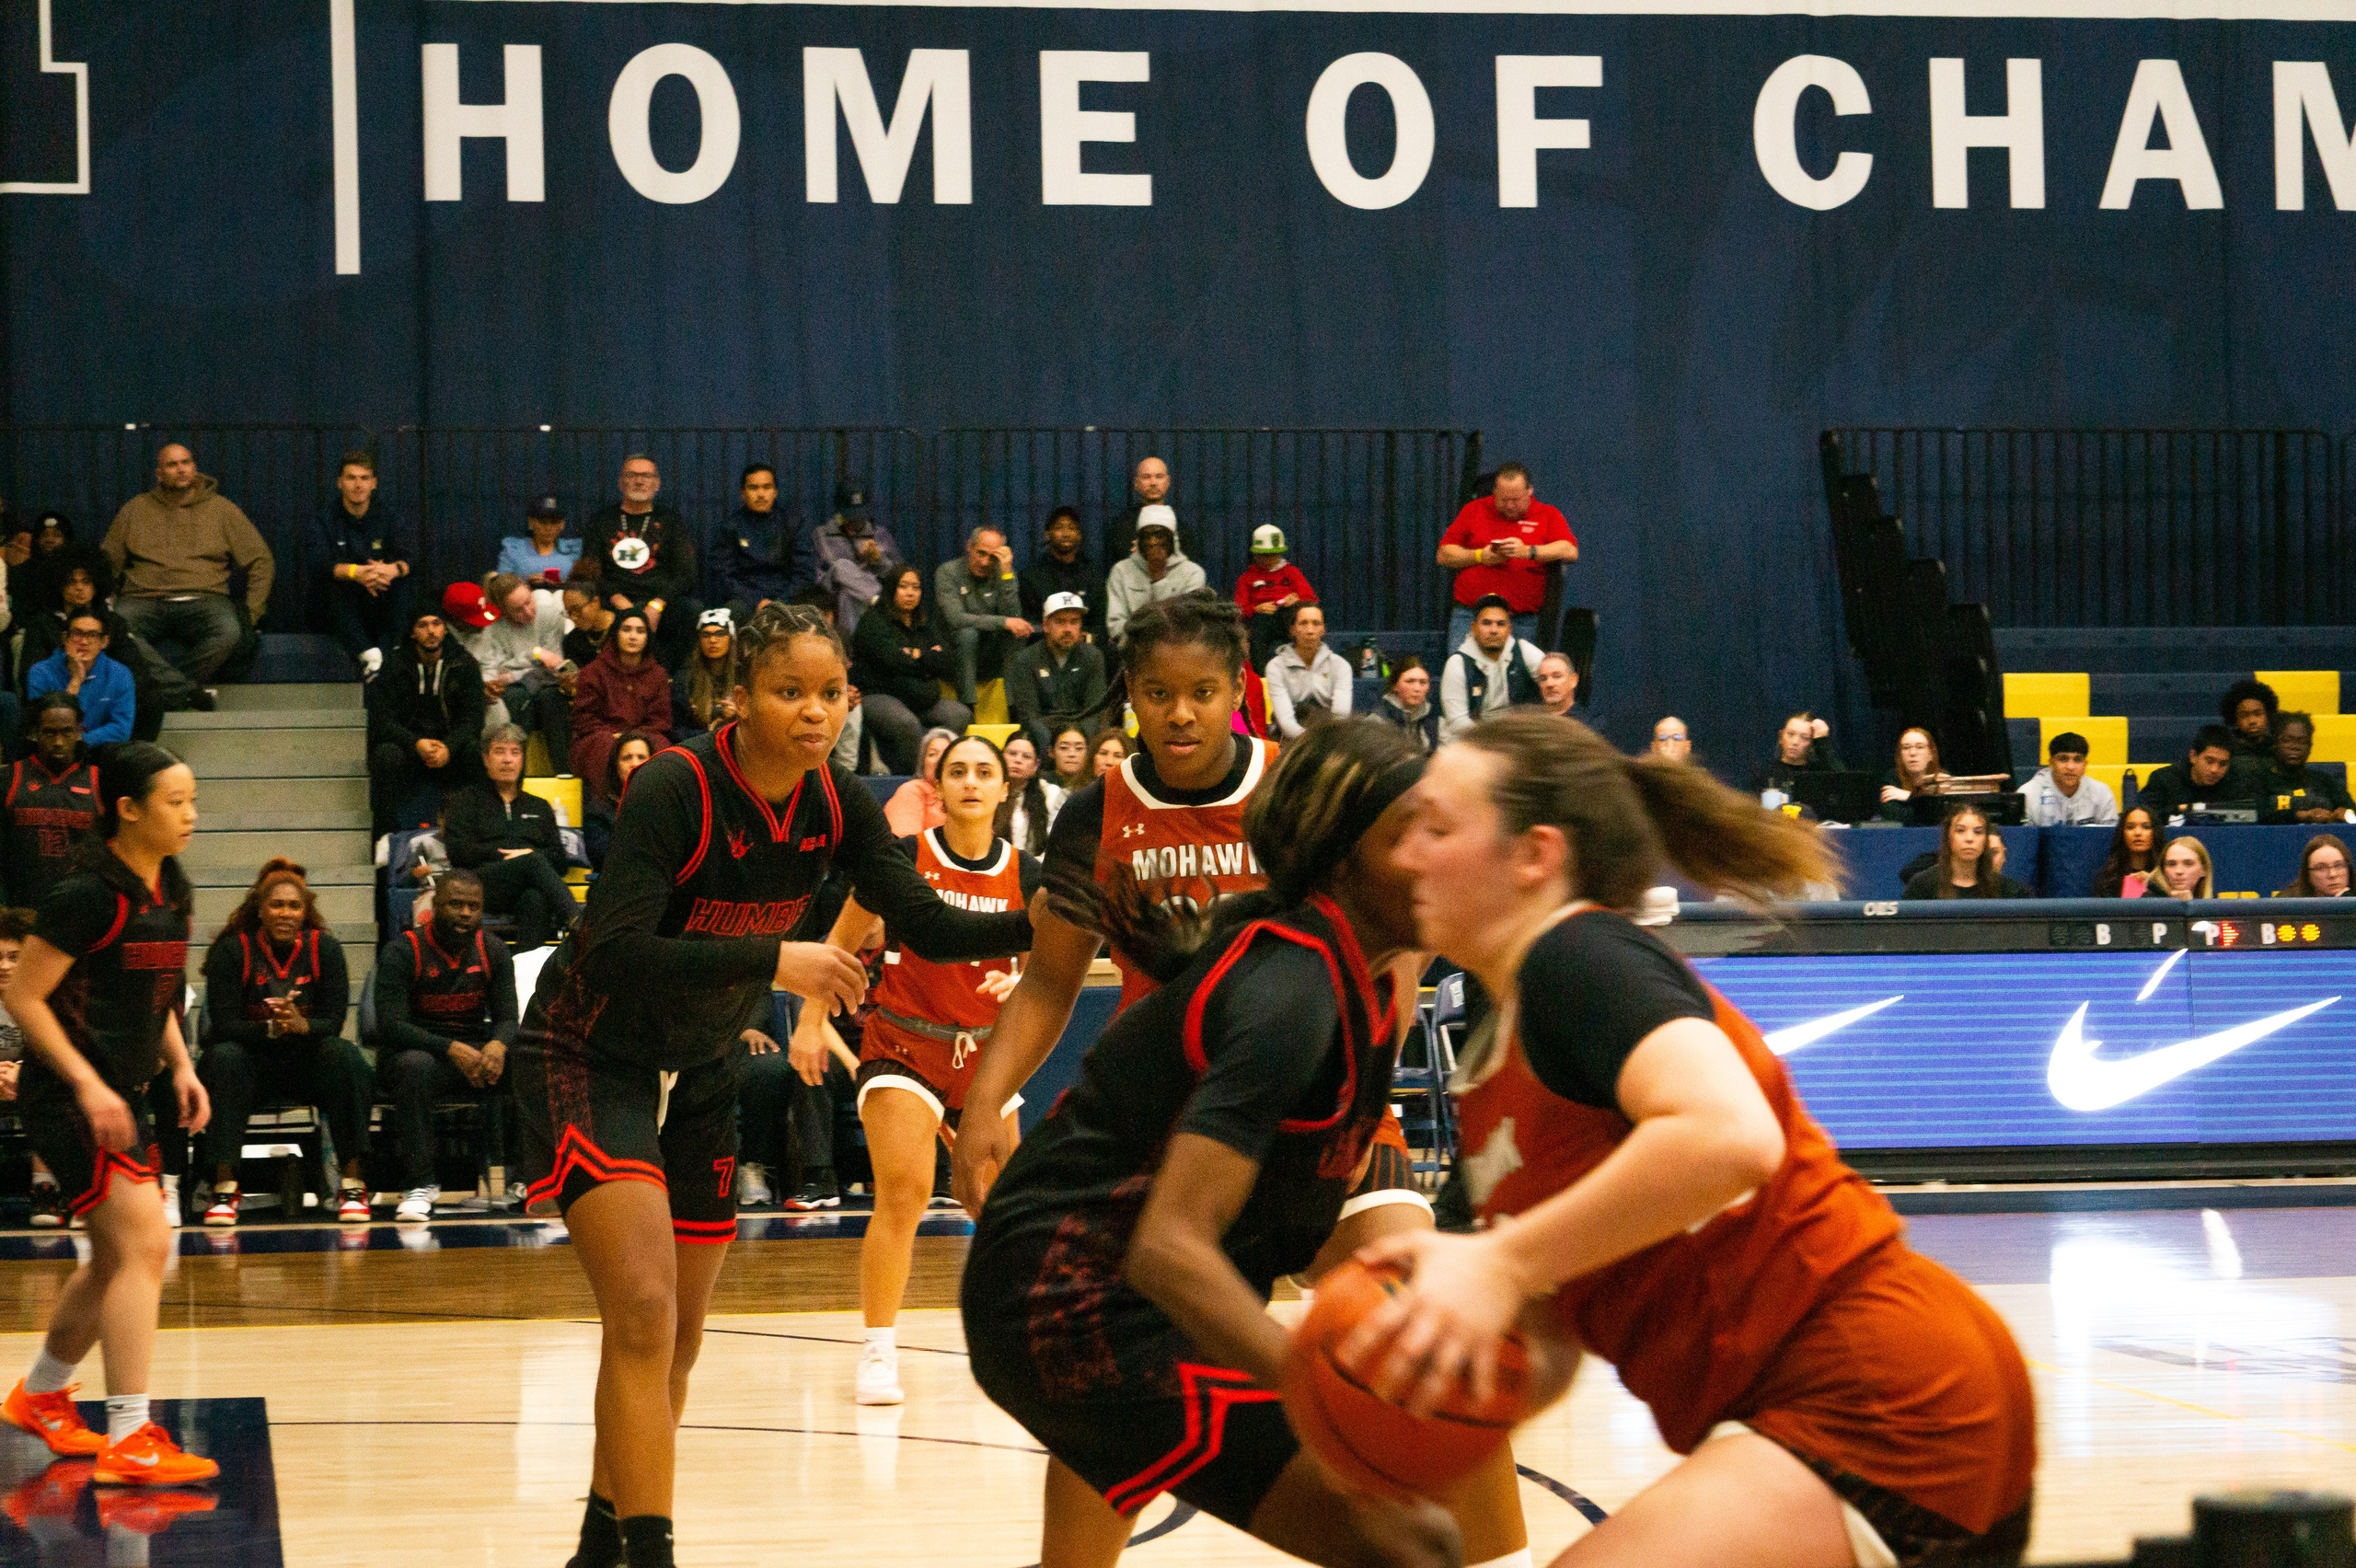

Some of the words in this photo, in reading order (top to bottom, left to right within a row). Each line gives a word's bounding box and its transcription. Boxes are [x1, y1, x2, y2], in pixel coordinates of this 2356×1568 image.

[422, 42, 1153, 207] HOME
[1305, 52, 1603, 211] OF
[2096, 923, 2111, 945] B
[2152, 922, 2167, 944] P
[2260, 923, 2277, 944] B
[713, 1156, 734, 1197] 7
